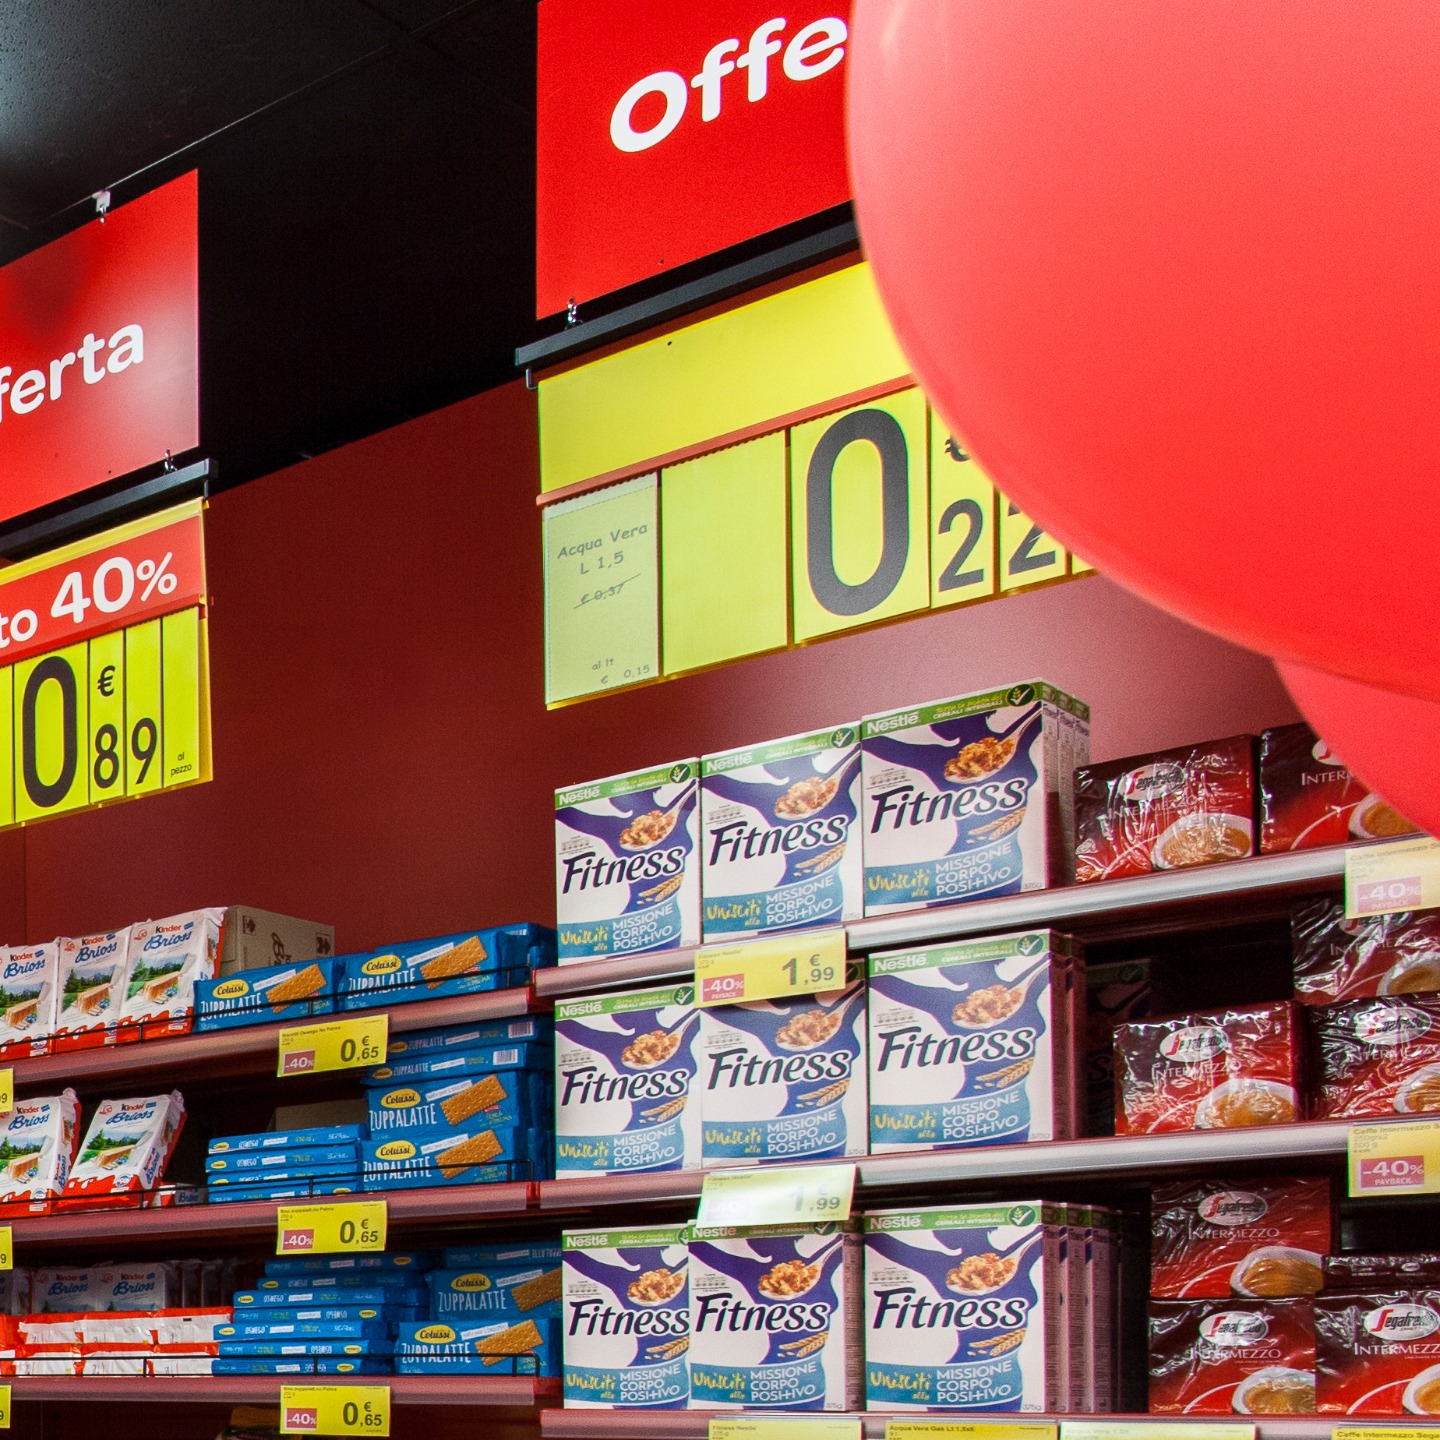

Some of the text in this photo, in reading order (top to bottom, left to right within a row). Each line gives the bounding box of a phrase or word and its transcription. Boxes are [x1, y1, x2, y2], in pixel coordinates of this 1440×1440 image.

[805, 408, 909, 617] 0
[557, 522, 649, 561] Acqua Vera
[579, 557, 589, 574] L
[50, 552, 178, 623] 40%
[22, 655, 78, 808] 0
[867, 711, 919, 734] Nestlé
[177, 751, 185, 762] al
[170, 763, 192, 778] pezzo
[871, 777, 1026, 834] Fitness
[562, 846, 684, 894] Fitness
[935, 841, 1013, 873] MISSIONE
[935, 865, 992, 885] CORPO
[143, 929, 193, 952] Brioss
[155, 921, 182, 934] kinder
[707, 1049, 852, 1090] Fitness
[369, 1105, 437, 1132] ZUPPALATTE
[1187, 1226, 1280, 1242] INTERMEZZO
